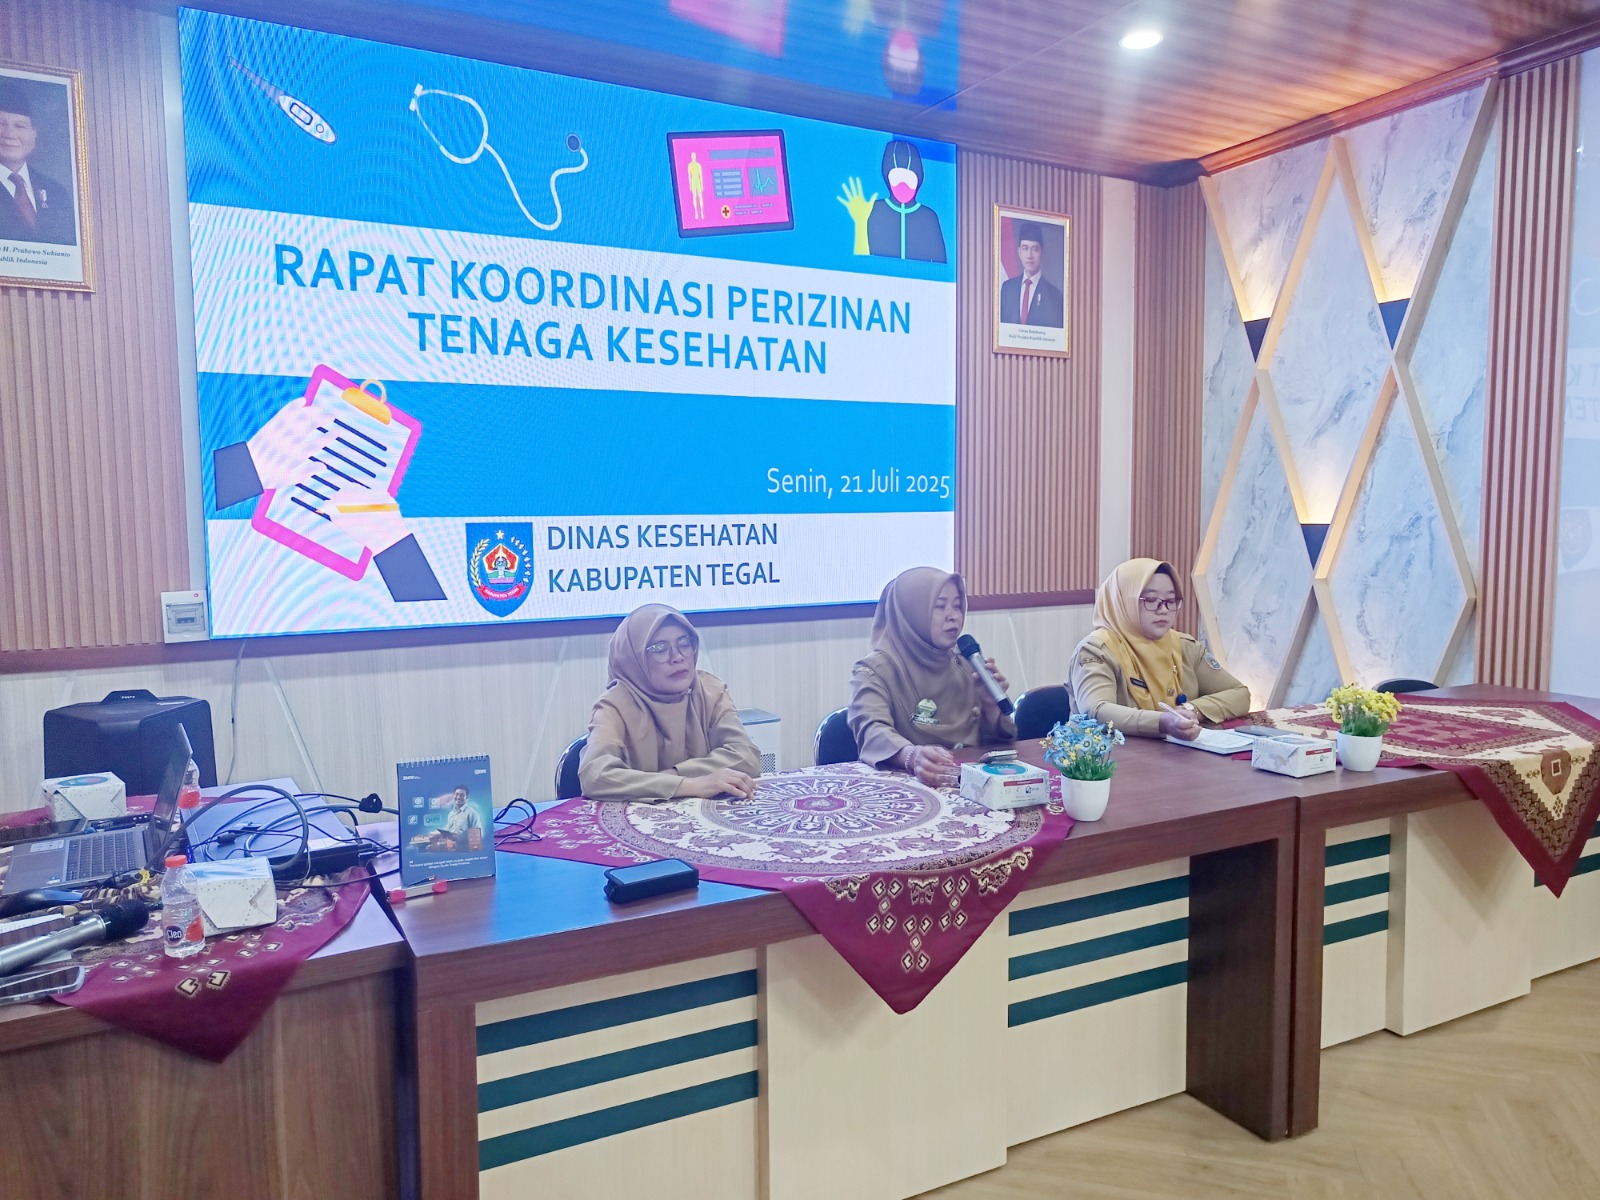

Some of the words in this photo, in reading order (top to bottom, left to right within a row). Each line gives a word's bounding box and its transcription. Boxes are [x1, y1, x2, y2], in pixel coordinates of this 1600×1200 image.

[273, 243, 435, 297] RAPAT
[450, 259, 714, 320] KOORDINASI
[727, 285, 911, 335] PERIZINAN
[407, 311, 594, 362] TENAGA
[607, 325, 826, 375] KESEHATAN
[767, 467, 834, 499] Senin,
[840, 475, 863, 493] 21
[867, 467, 899, 493] Juli
[906, 475, 950, 499] 2025
[547, 524, 630, 550] DINAS
[637, 523, 777, 549] KESEHATAN
[548, 564, 702, 593] KABUPATEN
[706, 561, 781, 587] TEGAL
[167, 929, 181, 938] Cleo
